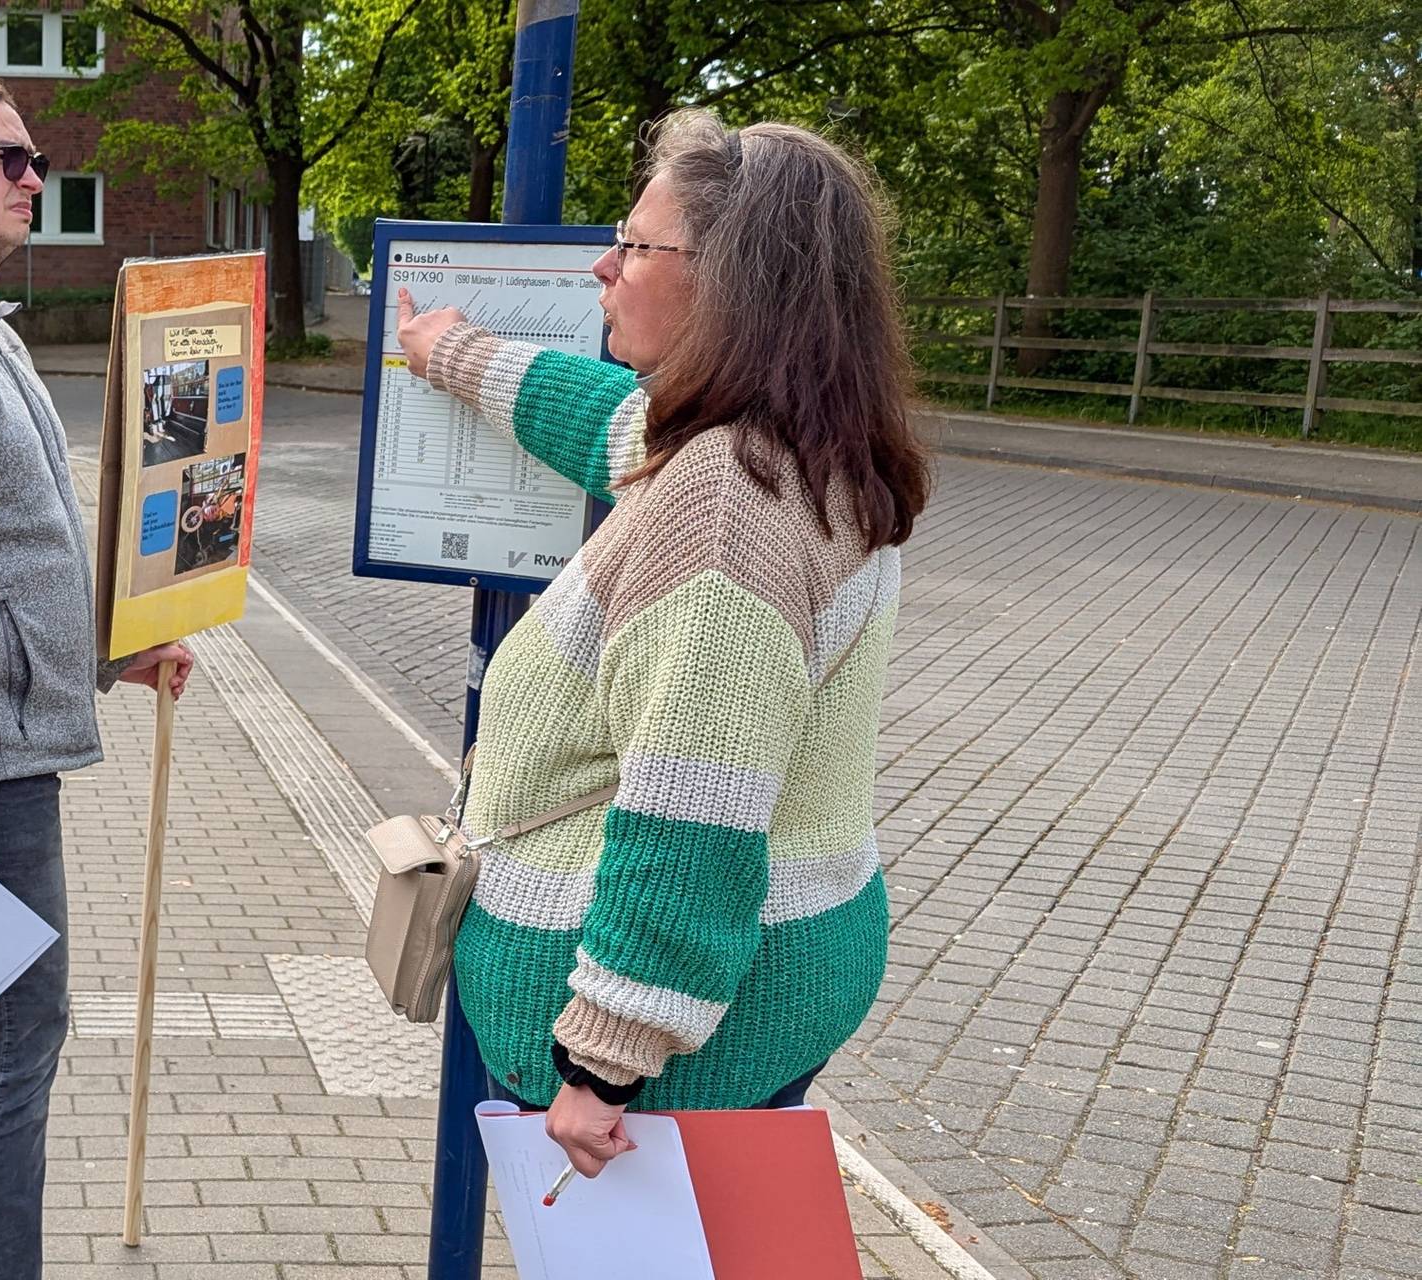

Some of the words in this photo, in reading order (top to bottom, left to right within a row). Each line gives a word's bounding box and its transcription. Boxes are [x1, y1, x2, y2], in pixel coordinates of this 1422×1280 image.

[405, 253, 439, 264] Busbf
[441, 254, 450, 264] A
[393, 270, 444, 284] S91/X90
[506, 275, 550, 288] Lüdinghausen
[556, 277, 574, 288] Olfen
[534, 553, 565, 568] RVM
